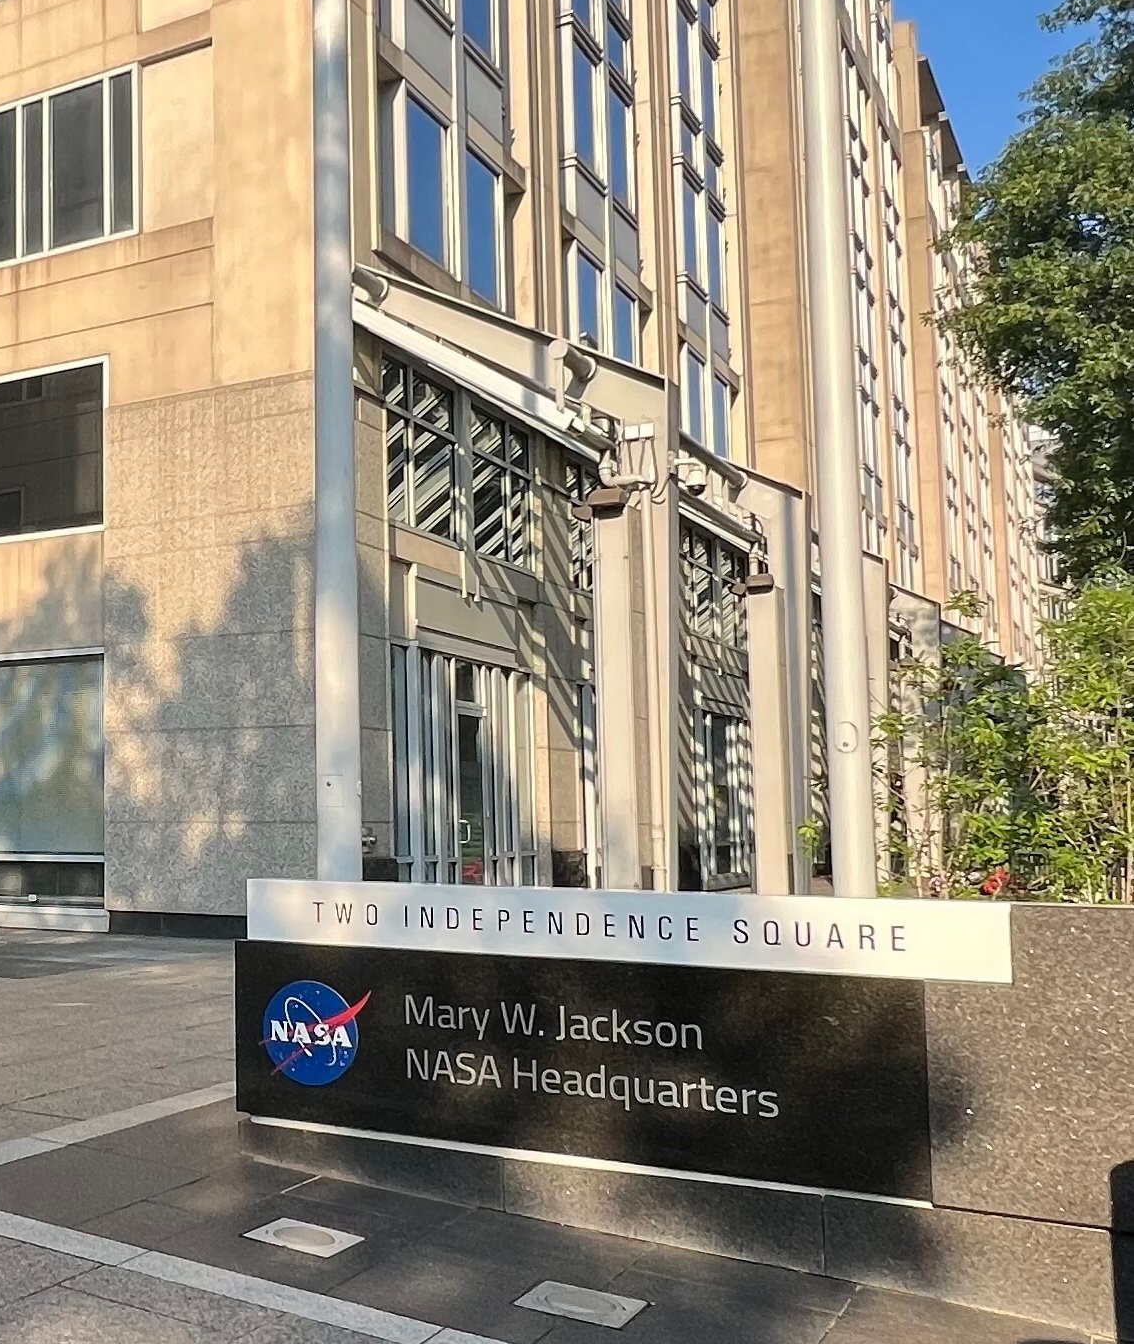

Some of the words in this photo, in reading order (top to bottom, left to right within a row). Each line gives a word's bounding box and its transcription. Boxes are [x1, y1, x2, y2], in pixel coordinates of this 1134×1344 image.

[312, 901, 378, 926] TWO
[403, 905, 699, 942] INDEPENDENCE
[733, 919, 906, 952] SQUARE
[270, 1019, 353, 1048] NASA
[404, 994, 490, 1040] Mary
[500, 1001, 544, 1036] W.
[555, 1005, 703, 1050] Jackson
[406, 1048, 502, 1089] NASA
[513, 1057, 780, 1118] Headquarters
